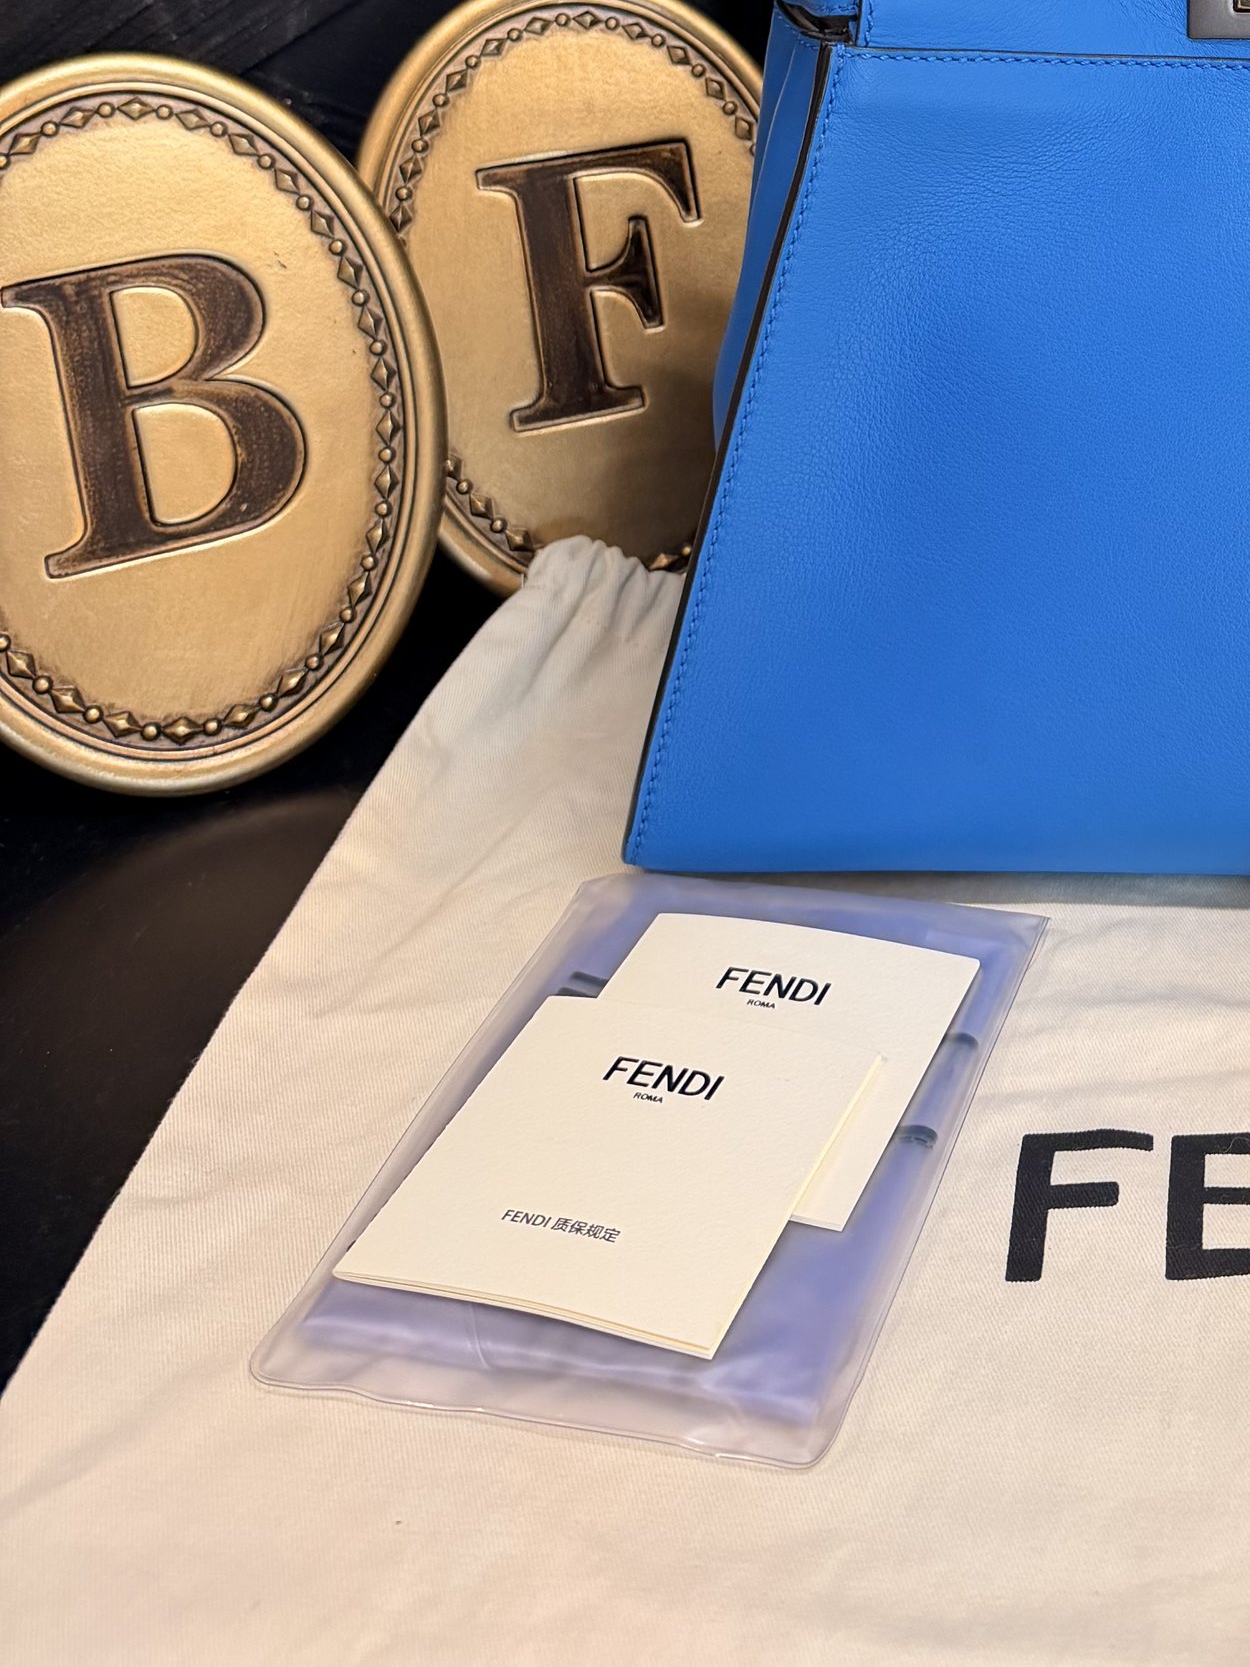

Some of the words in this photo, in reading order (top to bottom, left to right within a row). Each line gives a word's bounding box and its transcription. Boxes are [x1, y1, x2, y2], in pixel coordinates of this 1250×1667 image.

[476, 137, 703, 434] F
[0, 252, 308, 579] B
[715, 966, 832, 1006] FENDI
[746, 999, 776, 1009] ROMA
[602, 1056, 725, 1101] FENDI
[633, 1092, 663, 1103] ROMA
[501, 1209, 552, 1228] FENDI
[551, 1217, 621, 1243] 质保规定
